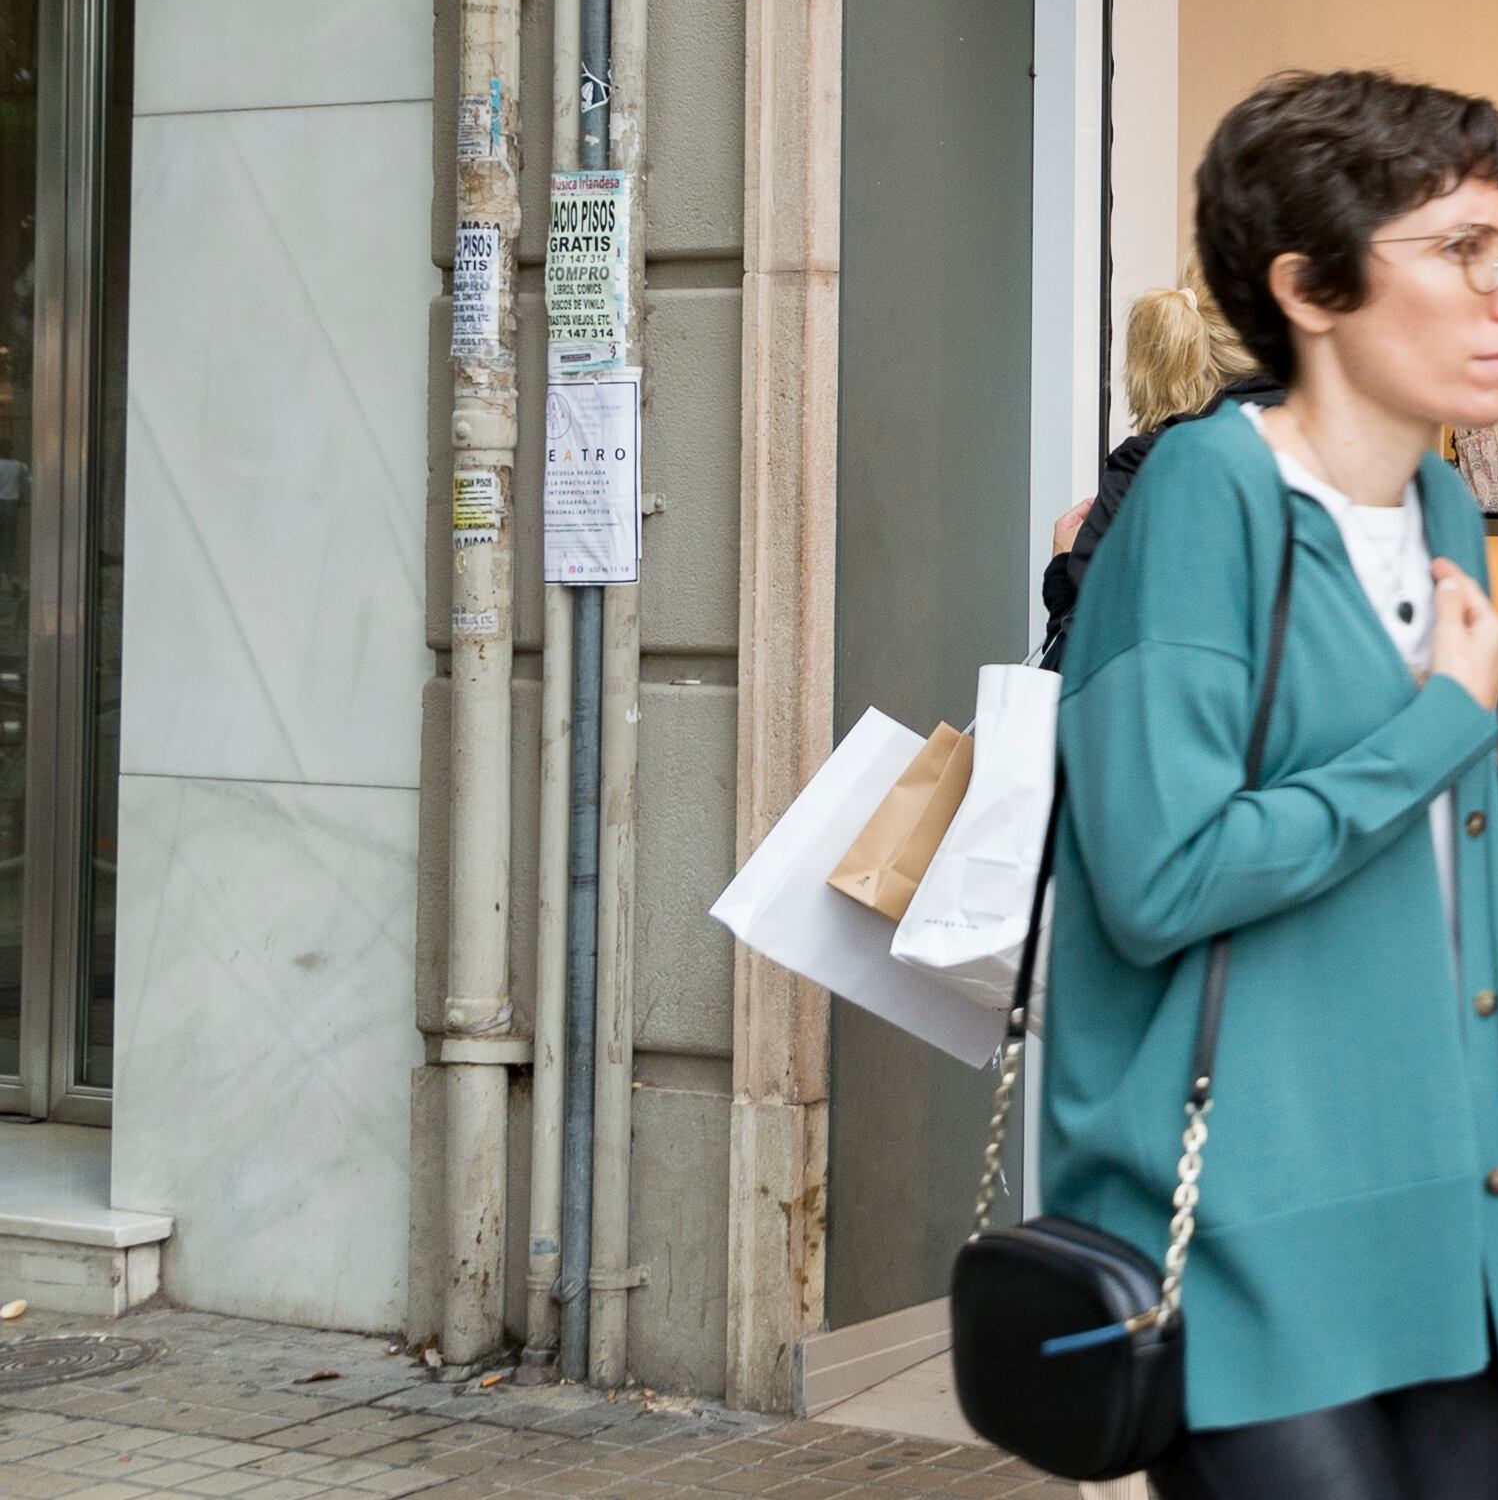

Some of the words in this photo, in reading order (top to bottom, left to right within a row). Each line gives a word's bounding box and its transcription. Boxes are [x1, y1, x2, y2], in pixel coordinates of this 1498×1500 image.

[581, 200, 615, 232] PISOS
[550, 236, 611, 252] GRATIS
[548, 266, 610, 281] COMPRO
[567, 329, 587, 338] 147
[591, 329, 614, 338] 314
